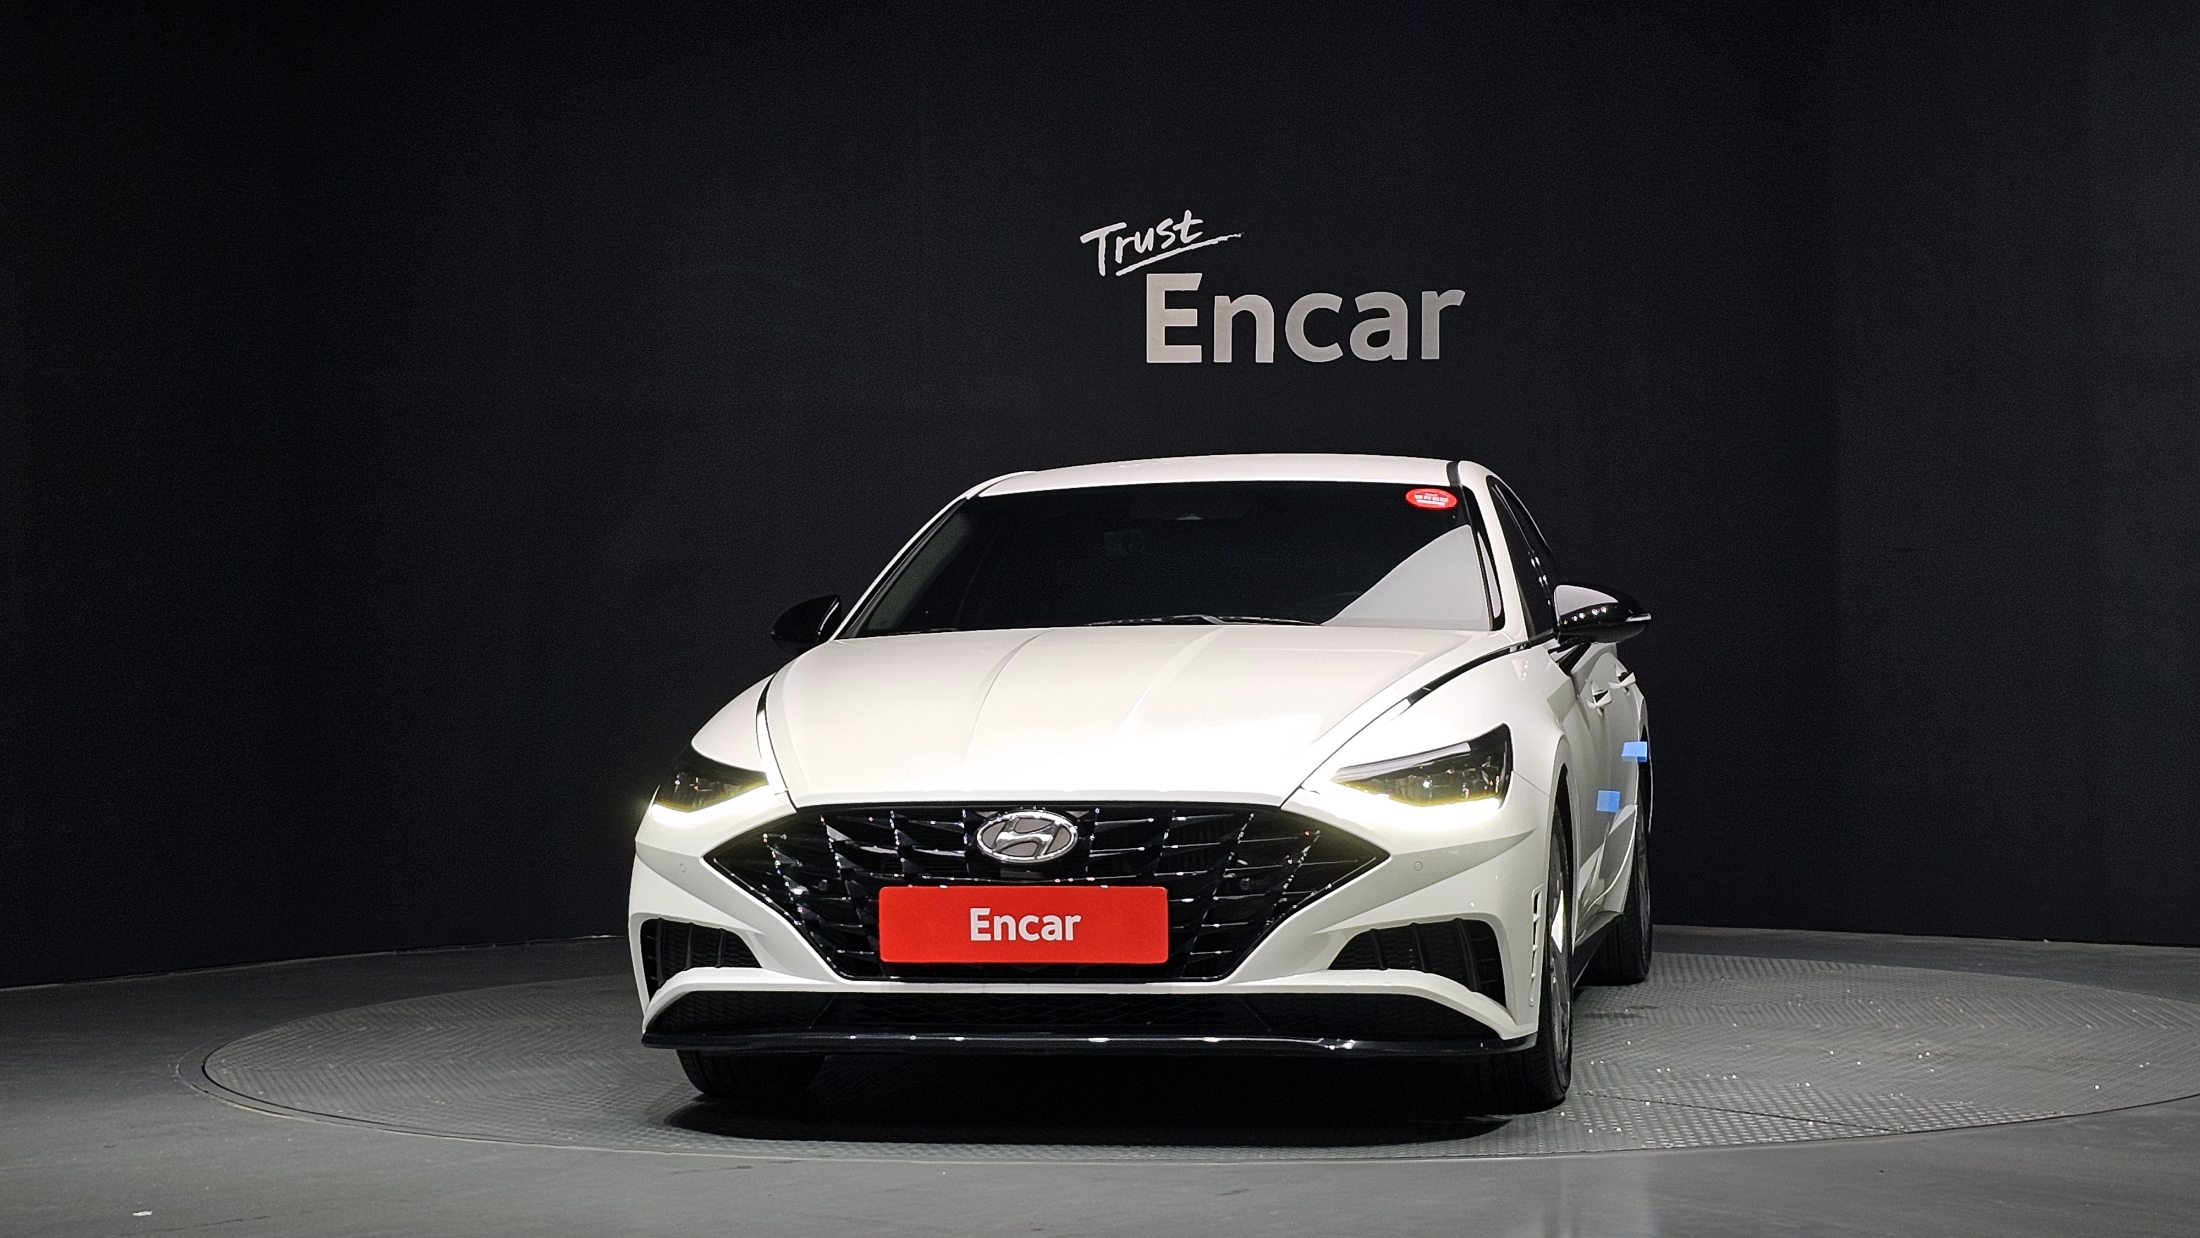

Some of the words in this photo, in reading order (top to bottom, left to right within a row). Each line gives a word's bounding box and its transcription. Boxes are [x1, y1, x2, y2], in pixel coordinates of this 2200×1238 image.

[1080, 209, 1204, 276] Trust
[1146, 272, 1466, 363] Encar
[969, 907, 1081, 942] Encar
